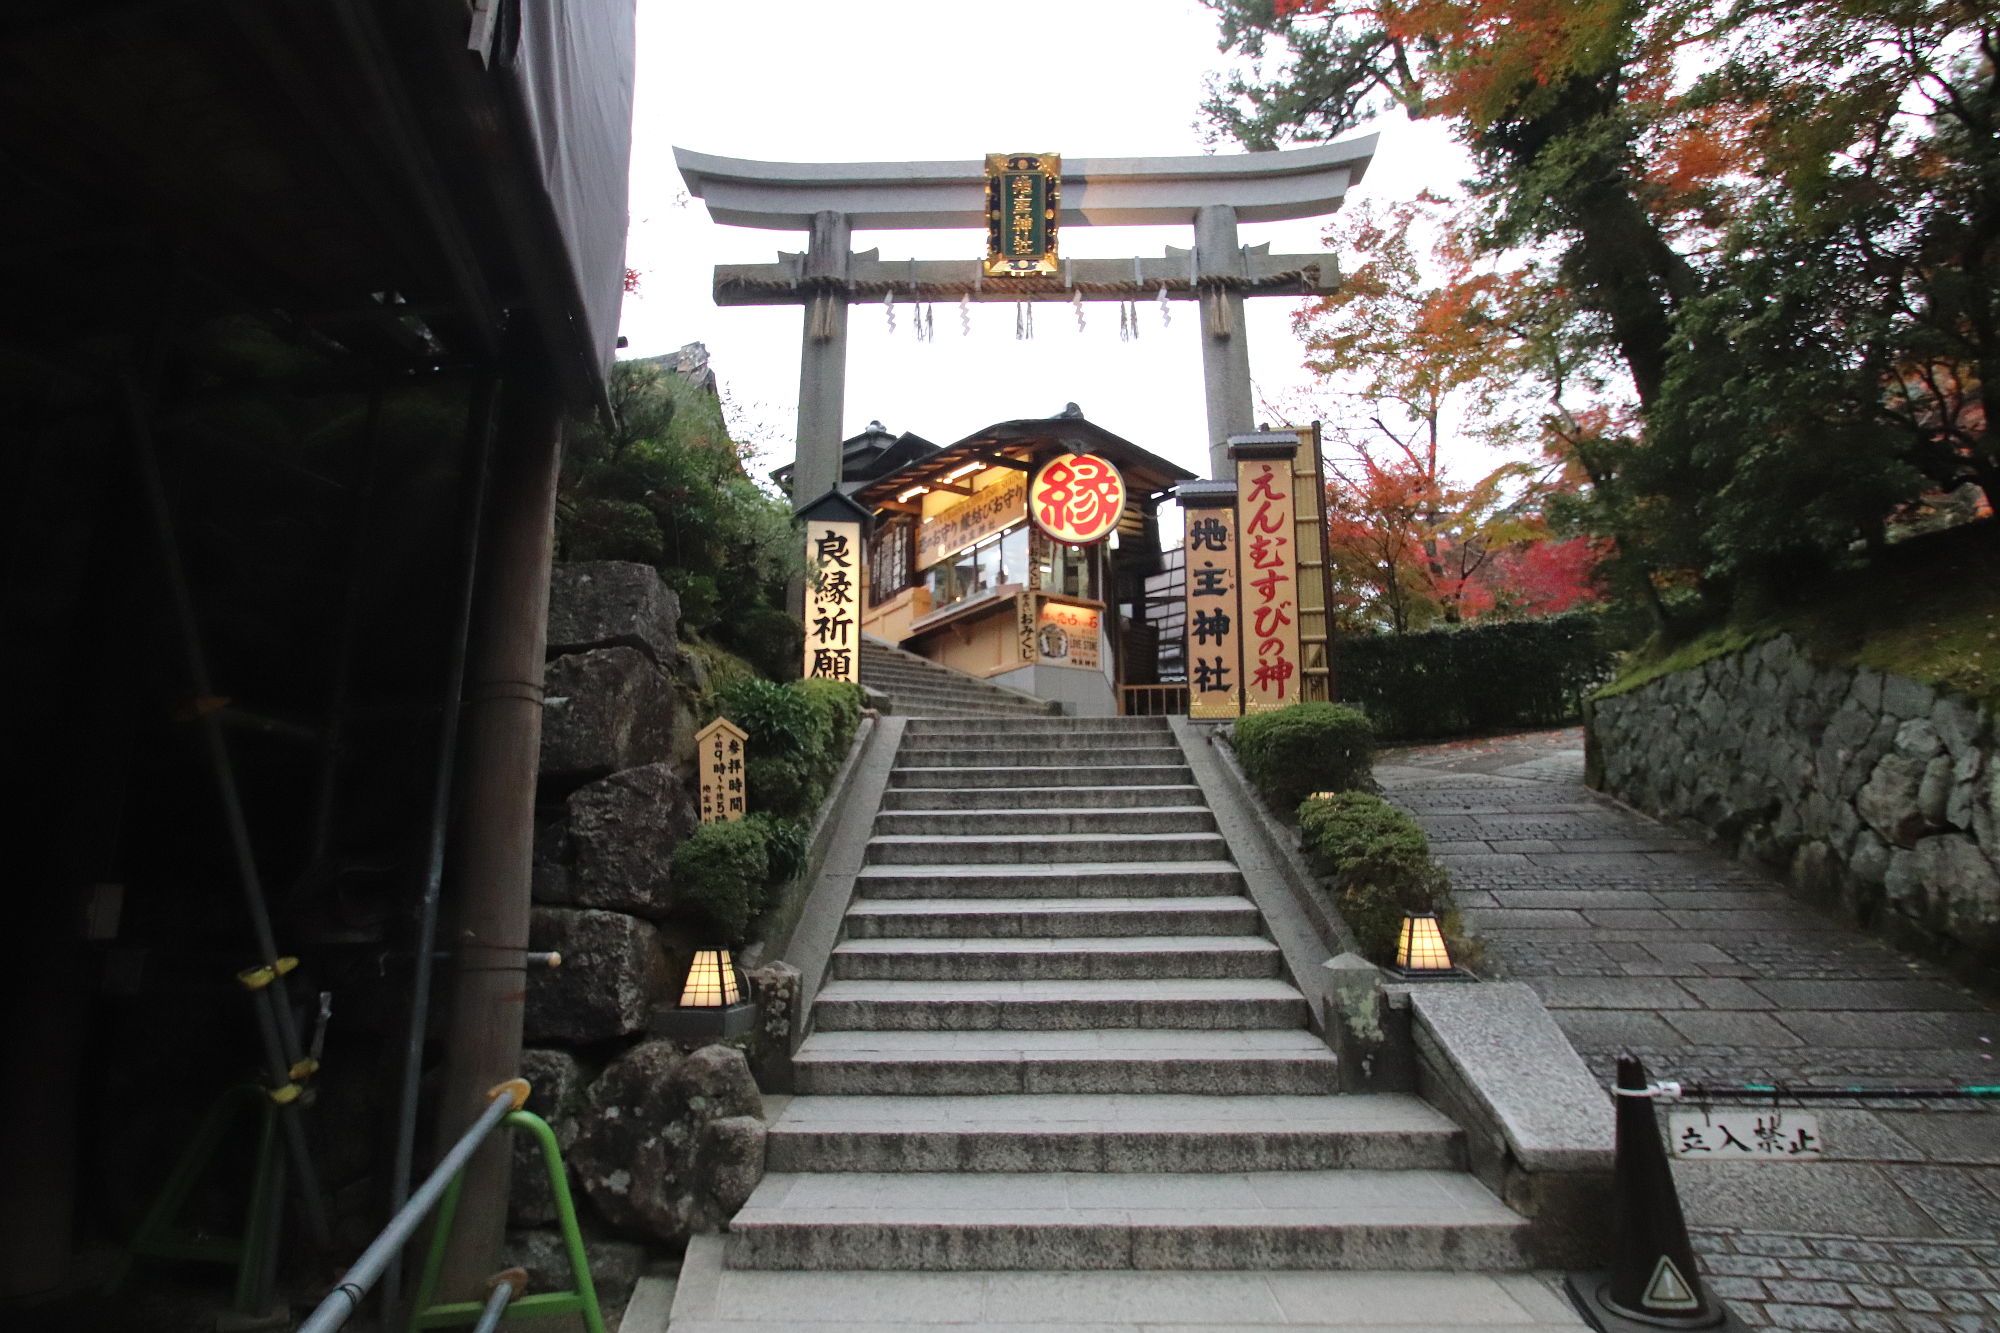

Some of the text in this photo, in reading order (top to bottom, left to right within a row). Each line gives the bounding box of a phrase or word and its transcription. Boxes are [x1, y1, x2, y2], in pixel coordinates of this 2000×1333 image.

[1038, 455, 1120, 536] 縁
[811, 530, 853, 683] 良縁祈願
[1191, 517, 1233, 693] 地主神社
[1247, 465, 1294, 699] えんむすびの神
[728, 739, 742, 813] 参拝時間
[1681, 1116, 1820, 1154] 立入禁止
